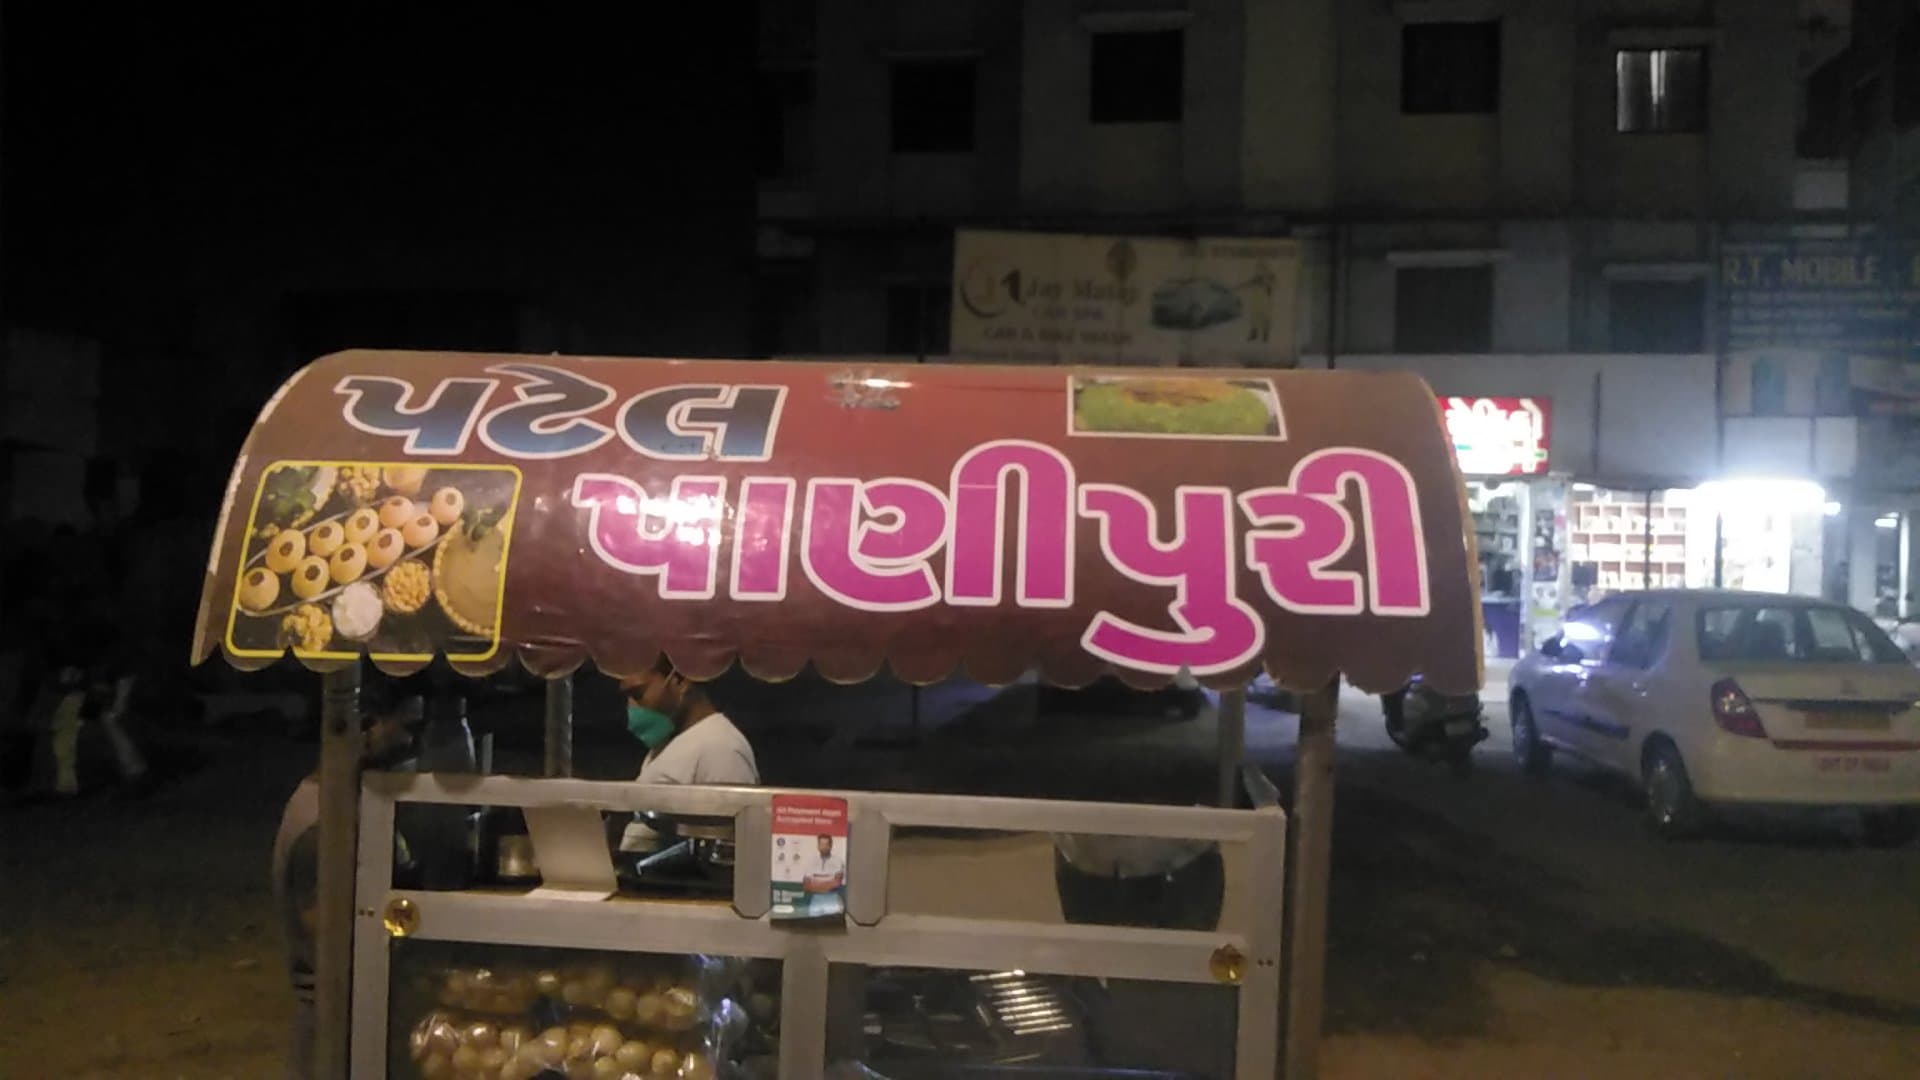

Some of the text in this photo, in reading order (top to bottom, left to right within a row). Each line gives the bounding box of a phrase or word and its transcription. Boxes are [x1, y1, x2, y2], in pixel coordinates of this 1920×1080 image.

[1781, 256, 1880, 286] MOBILE
[335, 364, 789, 460] પટેલ
[572, 439, 1430, 675] પાણીપુરી
[776, 815, 814, 825] Accepted
[788, 806, 820, 817] Payment
